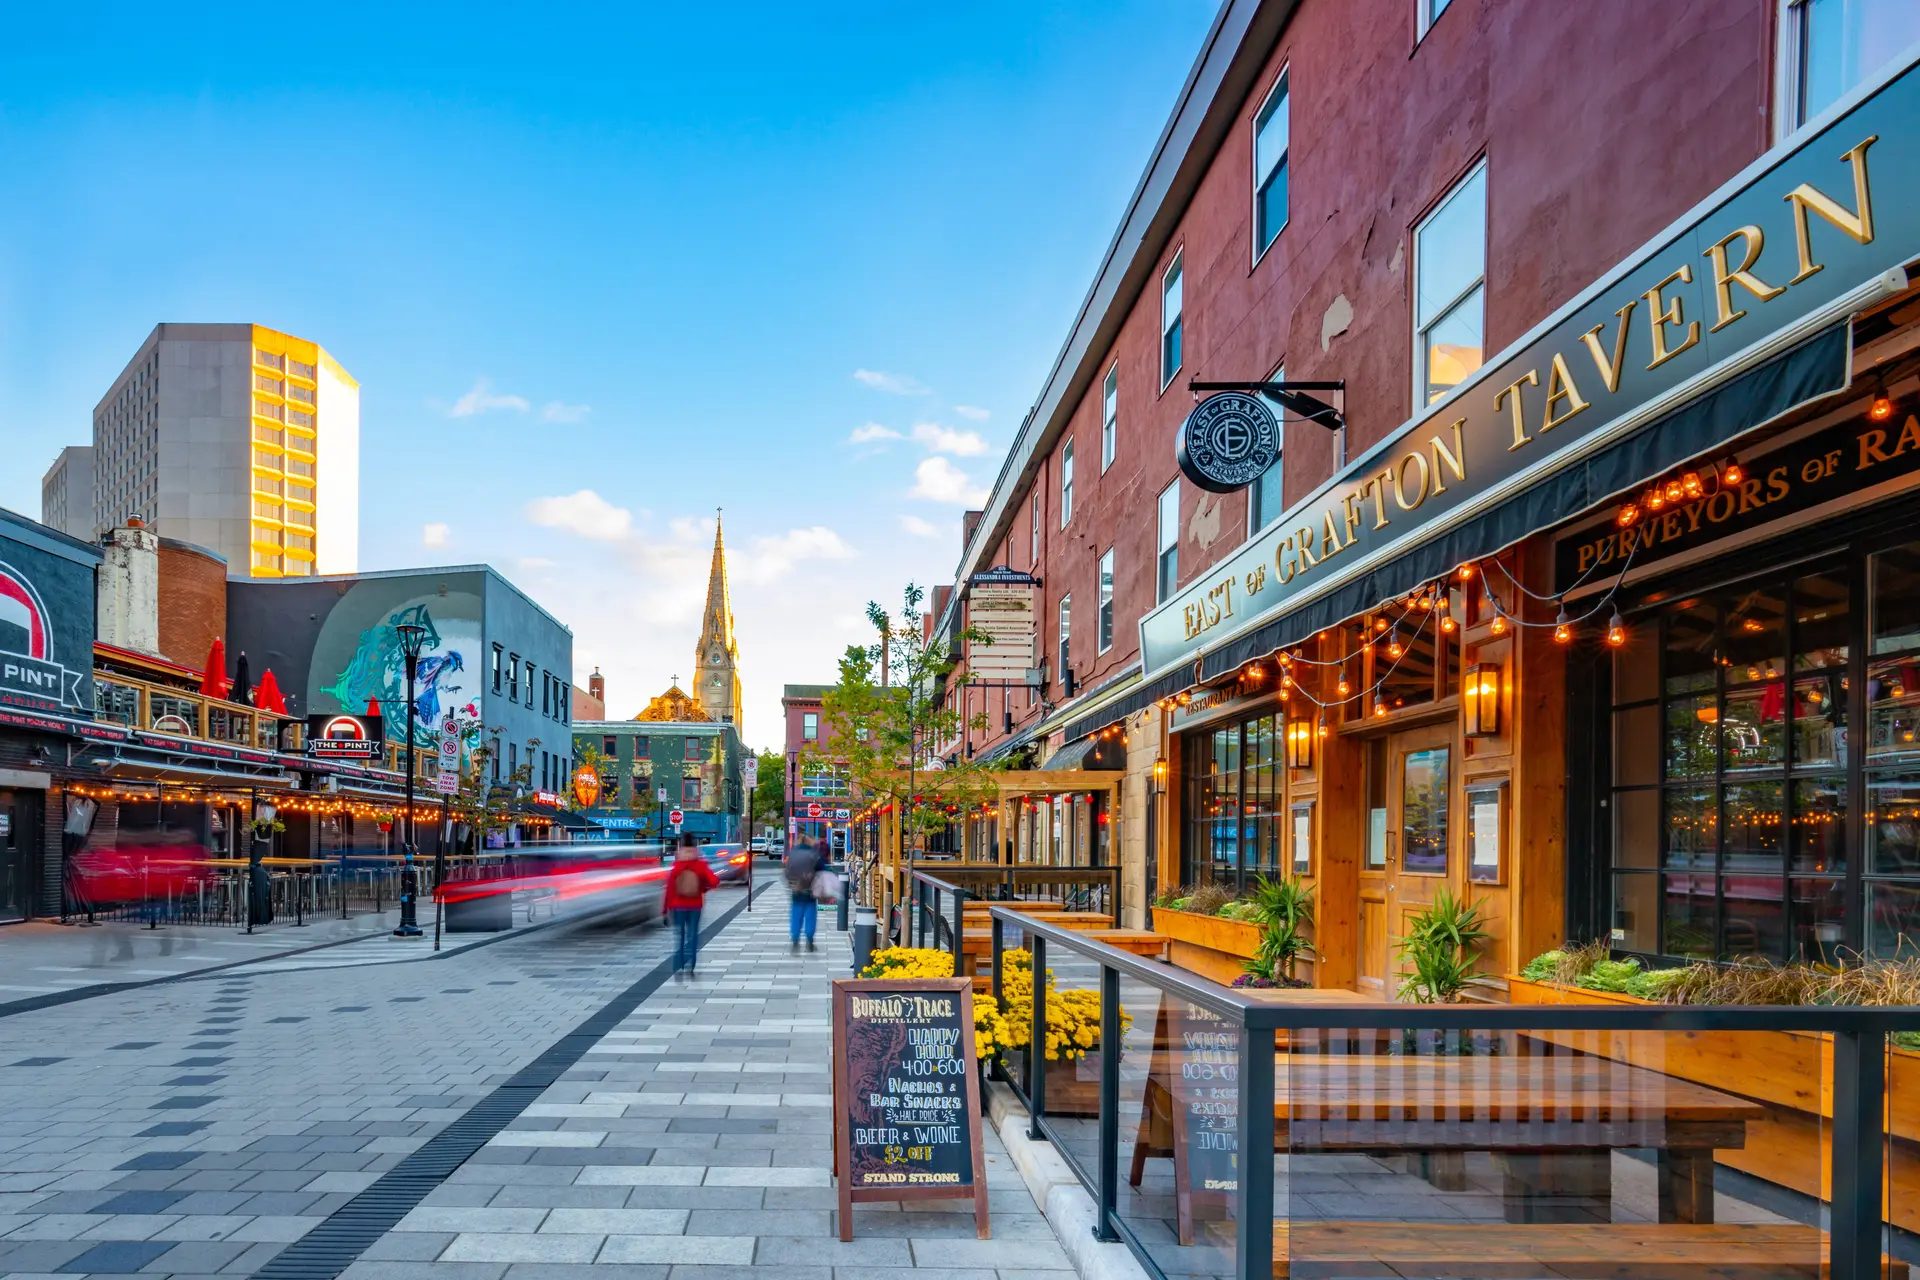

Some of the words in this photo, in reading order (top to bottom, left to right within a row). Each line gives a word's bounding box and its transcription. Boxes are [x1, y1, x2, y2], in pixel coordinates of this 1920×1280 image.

[1183, 576, 1235, 642] EAST
[1245, 564, 1267, 596] OF
[1274, 417, 1467, 585] GRAFTON
[1493, 134, 1879, 452] TAVERN
[1194, 410, 1214, 447] EAST
[1220, 400, 1272, 446] GRAFTON
[1577, 466, 1791, 574] PURVEYORS
[1801, 449, 1842, 484] OF
[4, 664, 57, 688] PINT
[1185, 687, 1235, 716] RESTAURANT
[596, 818, 635, 827] CENTRE
[852, 996, 903, 1018] BUFFALO
[908, 1028, 960, 1045] HAPPY
[915, 1045, 955, 1059] HOUR
[949, 1083, 957, 1092] &
[899, 1109, 917, 1121] HALF
[919, 1109, 938, 1122] PRICE
[856, 1128, 900, 1145] BEER
[902, 1131, 910, 1141] &
[914, 1126, 962, 1144] WINE
[884, 1145, 908, 1165] $2
[908, 1146, 935, 1161] OFF
[864, 1173, 906, 1183] STAND
[909, 1172, 960, 1183] STRONG
